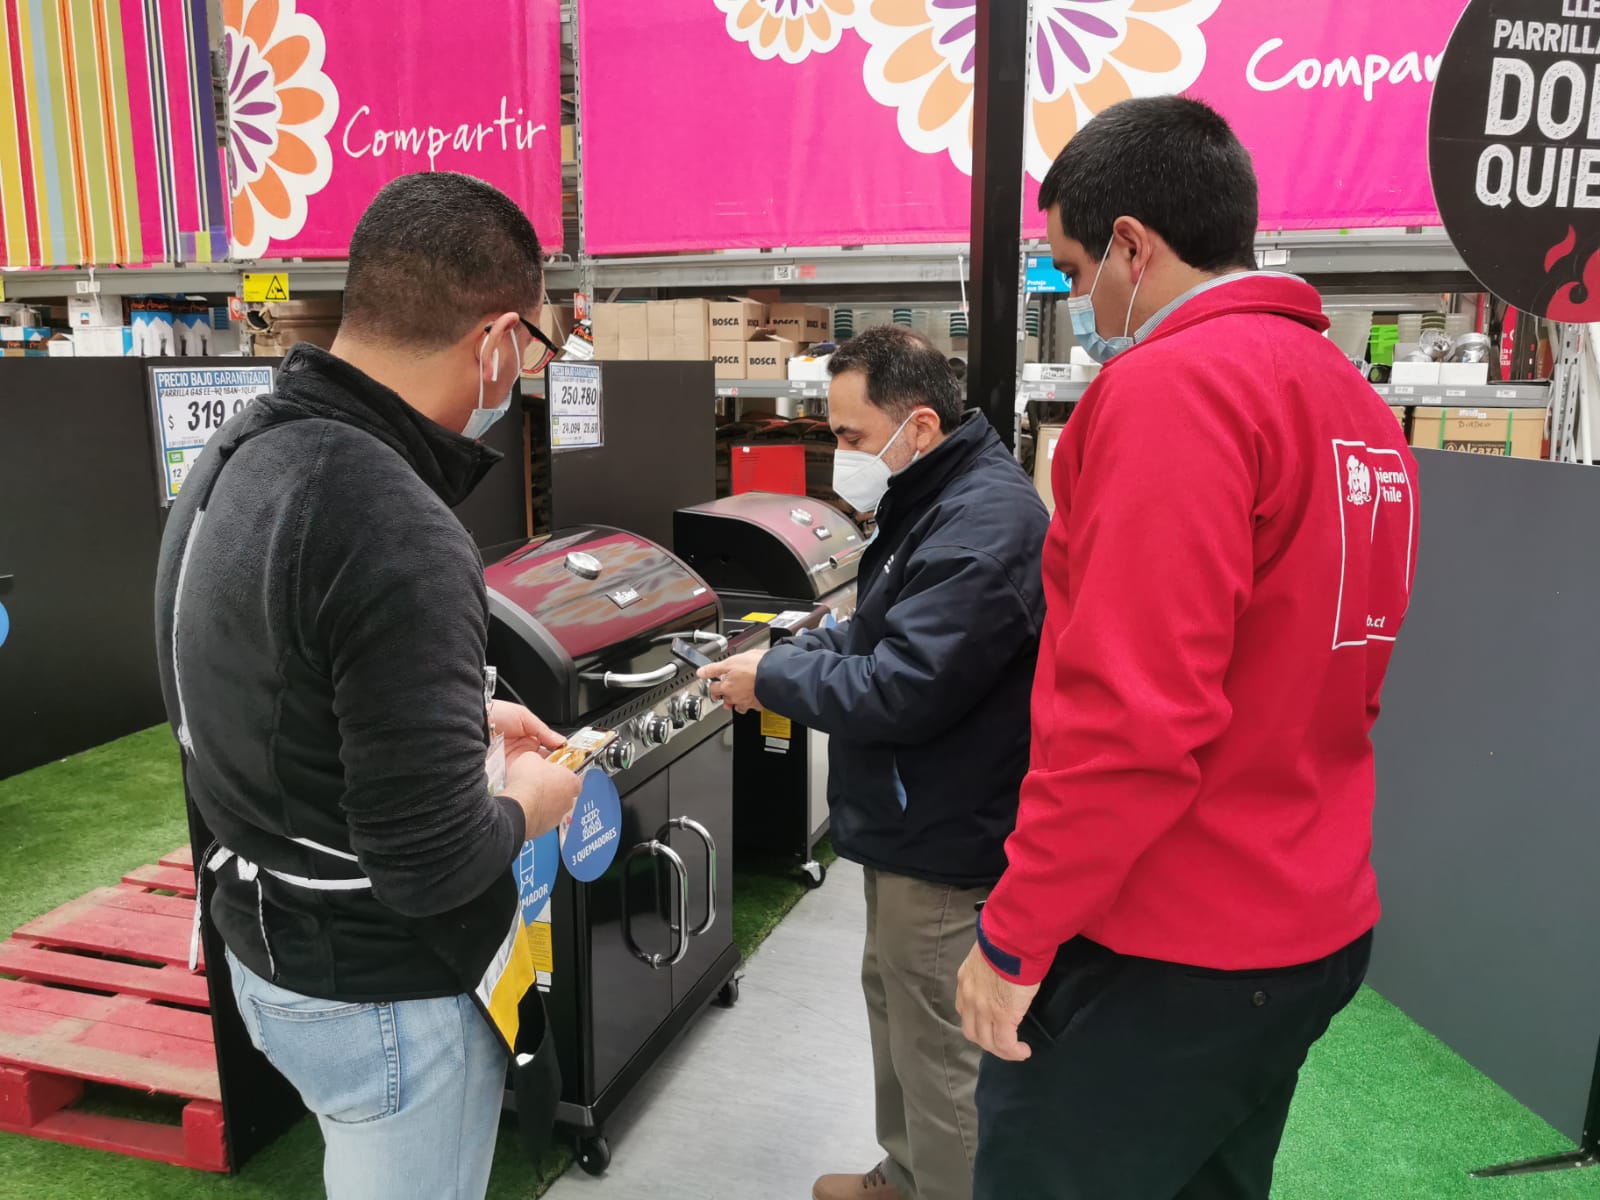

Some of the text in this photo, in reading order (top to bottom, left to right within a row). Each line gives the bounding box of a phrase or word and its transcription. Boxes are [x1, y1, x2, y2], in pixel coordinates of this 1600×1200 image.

[1484, 57, 1600, 140] DO
[343, 96, 546, 171] Compartir
[1475, 144, 1600, 209] QUIE
[712, 318, 739, 326] BOSCA
[712, 356, 739, 364] BOSCA
[750, 357, 776, 365] BOSCA
[159, 371, 269, 387] PRECIO BAJO GARANTIZADO
[561, 385, 597, 406] 250.780
[1380, 486, 1402, 503] hile
[572, 826, 617, 866] 3 QUEMADORES
